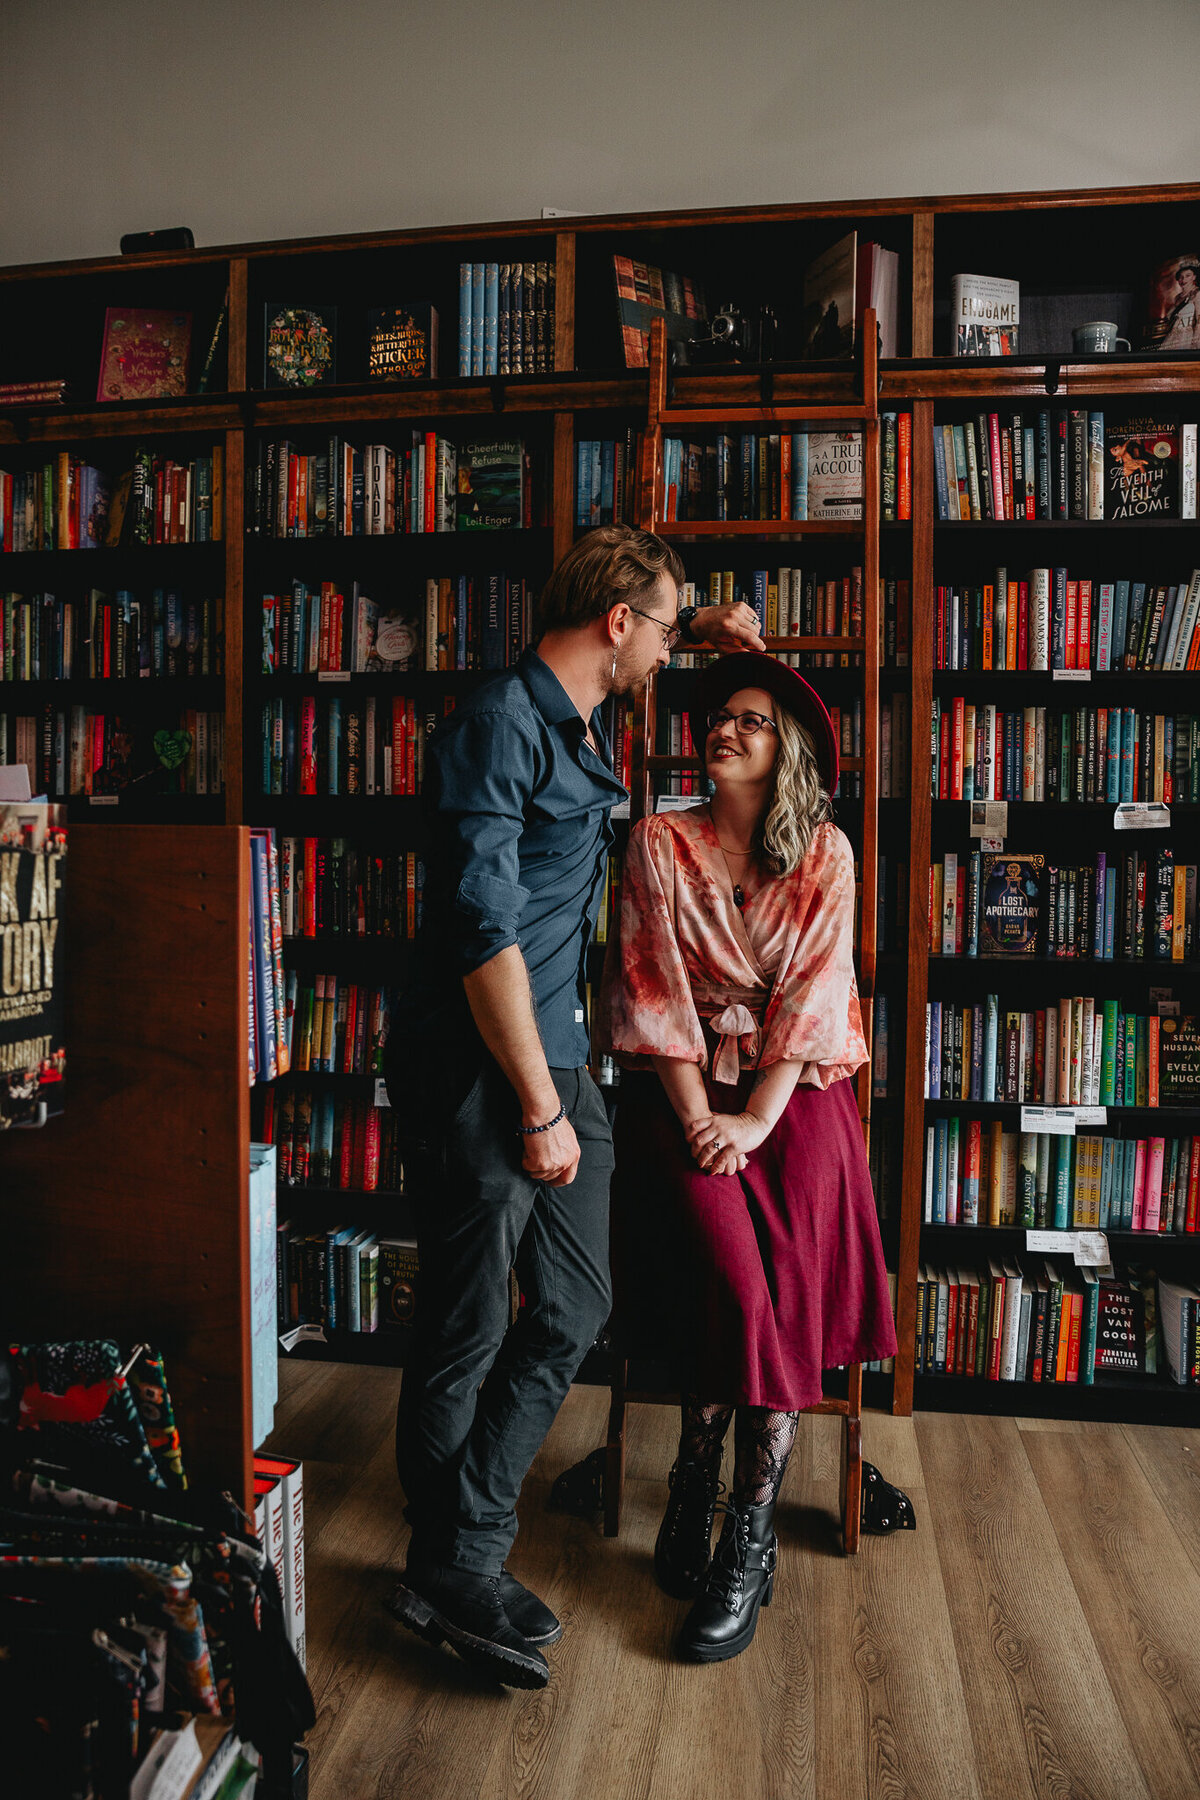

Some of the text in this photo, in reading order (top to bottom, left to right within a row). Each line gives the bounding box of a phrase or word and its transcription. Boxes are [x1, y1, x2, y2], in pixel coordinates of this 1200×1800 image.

[369, 348, 425, 367] STICKER
[370, 361, 426, 376] ANTHOLOGY
[127, 366, 163, 377] Nature
[1128, 416, 1154, 425] SILVIA
[466, 441, 516, 455] Cheerfully
[743, 443, 751, 464] HOUSE
[1013, 415, 1023, 481] GIRL BRAIDING HER HAIR
[1091, 420, 1104, 465] Vacationland
[471, 455, 502, 466] Refuse
[822, 451, 828, 459] A
[1075, 453, 1082, 462] OF
[134, 464, 144, 495] HESTER
[373, 448, 381, 517] TOAD
[1039, 458, 1048, 507] ILLUMINATIONS
[1110, 466, 1127, 479] The
[1110, 468, 1164, 491] SEVENTH
[882, 469, 895, 504] Search
[1074, 474, 1082, 501] WOODS
[1120, 483, 1162, 505] VEIL of
[813, 508, 851, 519] KATHERINE
[1111, 496, 1171, 521] SALOME
[465, 515, 513, 527] Leif Enger
[488, 576, 499, 630] KEN FOLLETT
[511, 584, 521, 636] KEN FOLLETT
[781, 572, 789, 630] Bloomsbury Girls
[1037, 598, 1045, 622] JOJO
[1102, 598, 1110, 608] BEE
[1081, 584, 1089, 645] THE DREAM BUILDERS
[1101, 609, 1110, 628] STING
[1148, 591, 1165, 646] HELLO BEAUTIFUL
[1177, 573, 1200, 661] CELESTE NG OUR MISSING HEARTS
[1037, 623, 1046, 653] MOYES
[1100, 632, 1108, 647] PAUL
[1099, 648, 1108, 671] MURRAY
[1088, 741, 1095, 750] OF
[317, 854, 326, 876] SAM
[29, 853, 62, 920] AF
[1137, 872, 1146, 891] Bear
[967, 882, 978, 939] AMALFI CURSE
[985, 904, 1040, 919] APOTHECARY
[1002, 896, 1024, 906] LOST
[1159, 890, 1169, 940] Jodi Picoult
[263, 965, 275, 998] TESSA
[263, 998, 276, 1035] BAILEY
[1184, 1054, 1192, 1062] of
[1091, 1138, 1099, 1175] INTERMEZZO
[1006, 1151, 1014, 1206] SHANTARAM
[1024, 1174, 1032, 1209] IDENTITY
[1077, 1200, 1085, 1224] ROONEY
[1089, 1201, 1097, 1225] ROONEY
[1107, 1294, 1131, 1303] THE
[1048, 1311, 1057, 1332] ROARING
[1104, 1306, 1134, 1316] LOST
[1107, 1318, 1132, 1329] VAN
[1035, 1323, 1043, 1356] ARIADNE
[1047, 1332, 1055, 1345] DAYS
[1102, 1330, 1136, 1341] GOGH
[1046, 1349, 1054, 1362] ZORA
[1100, 1356, 1139, 1367] SANTLOFER
[1102, 1348, 1137, 1360] JONATHAN
[272, 1503, 283, 1541] The
[291, 1480, 306, 1616] The Macabre
